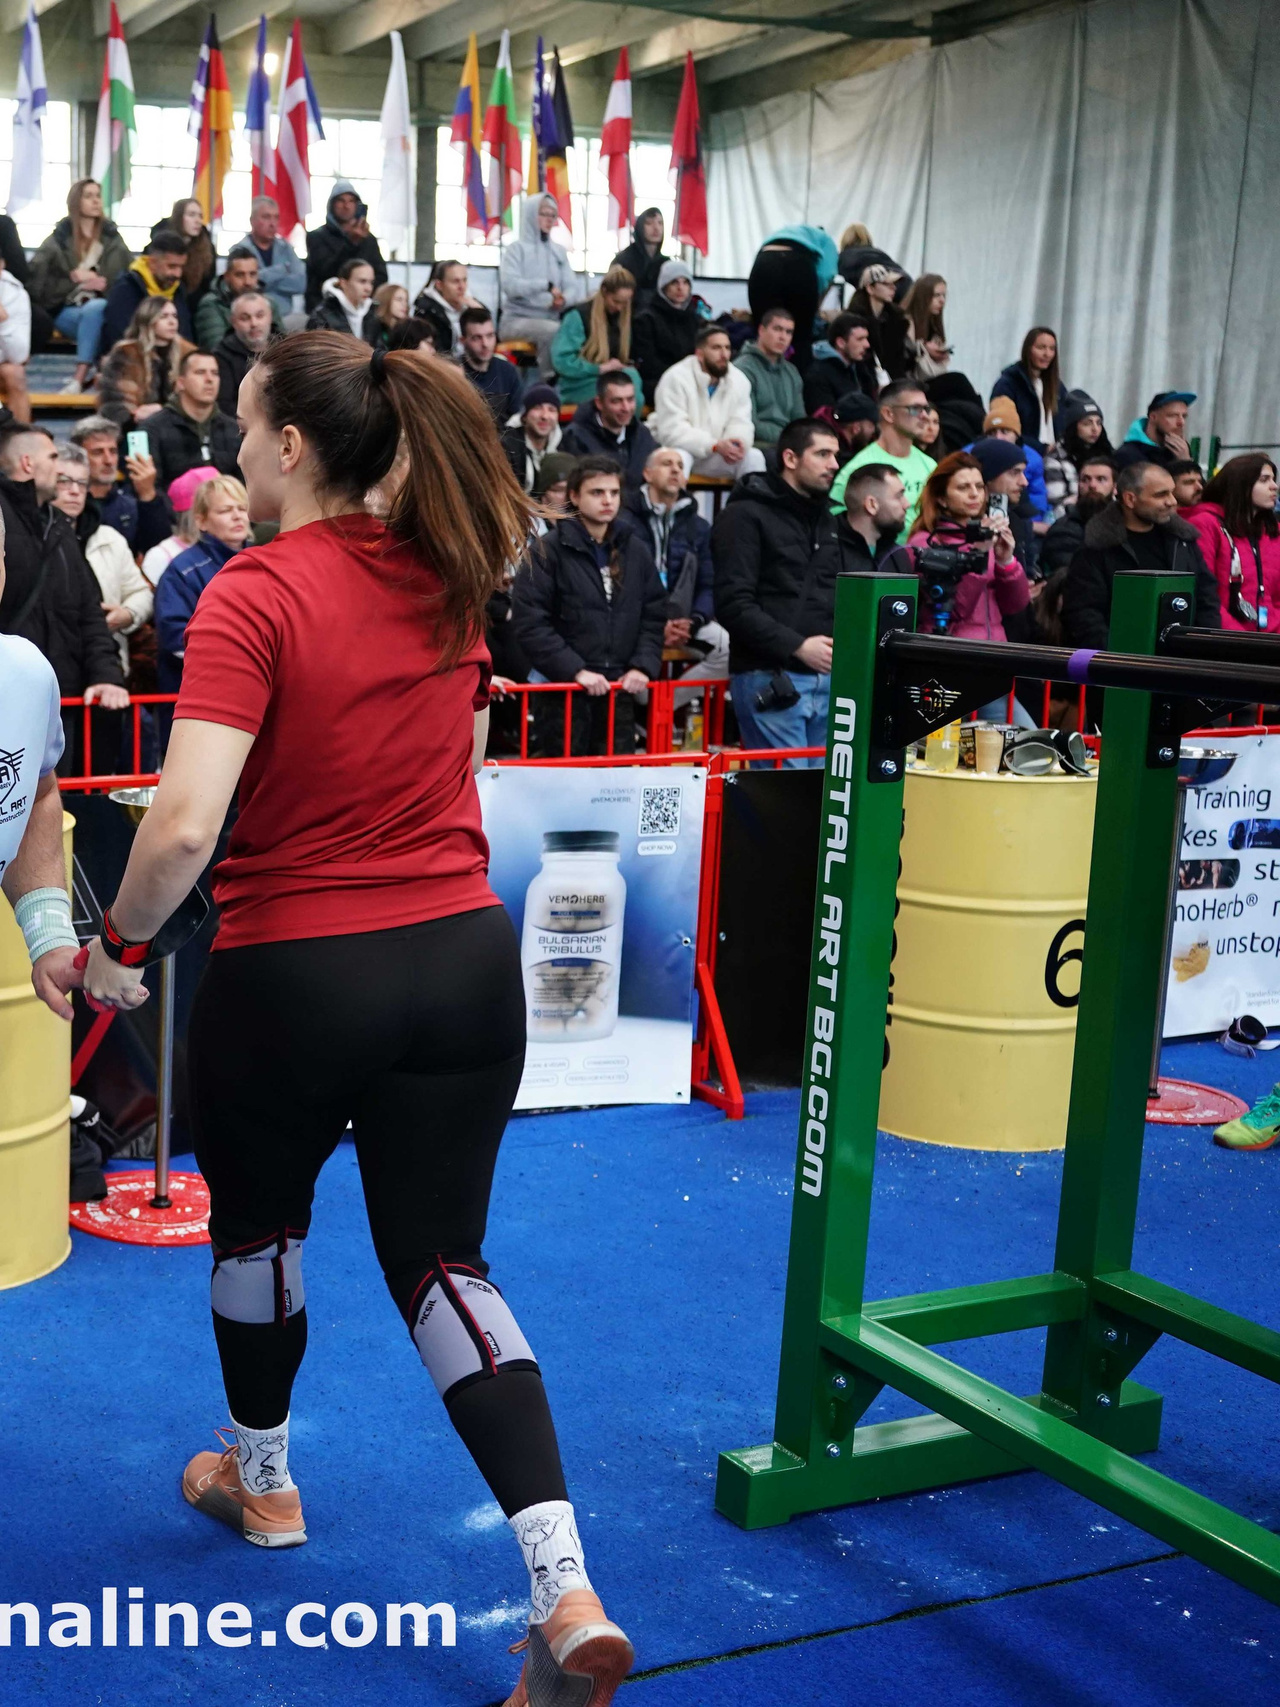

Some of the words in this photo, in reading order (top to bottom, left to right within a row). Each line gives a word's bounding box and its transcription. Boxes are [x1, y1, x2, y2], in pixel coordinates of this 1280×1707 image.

[823, 696, 857, 884] METAL
[1195, 784, 1272, 812] Training
[10, 795, 27, 813] ART
[538, 934, 607, 945] BULGARIAN
[542, 945, 602, 955] TRIBULUS
[816, 894, 843, 1002] ART
[1044, 918, 1086, 1009] 6
[801, 1005, 835, 1198] BG.COM
[466, 1279, 495, 1296] PICSIL
[418, 1299, 437, 1326] PICSIL
